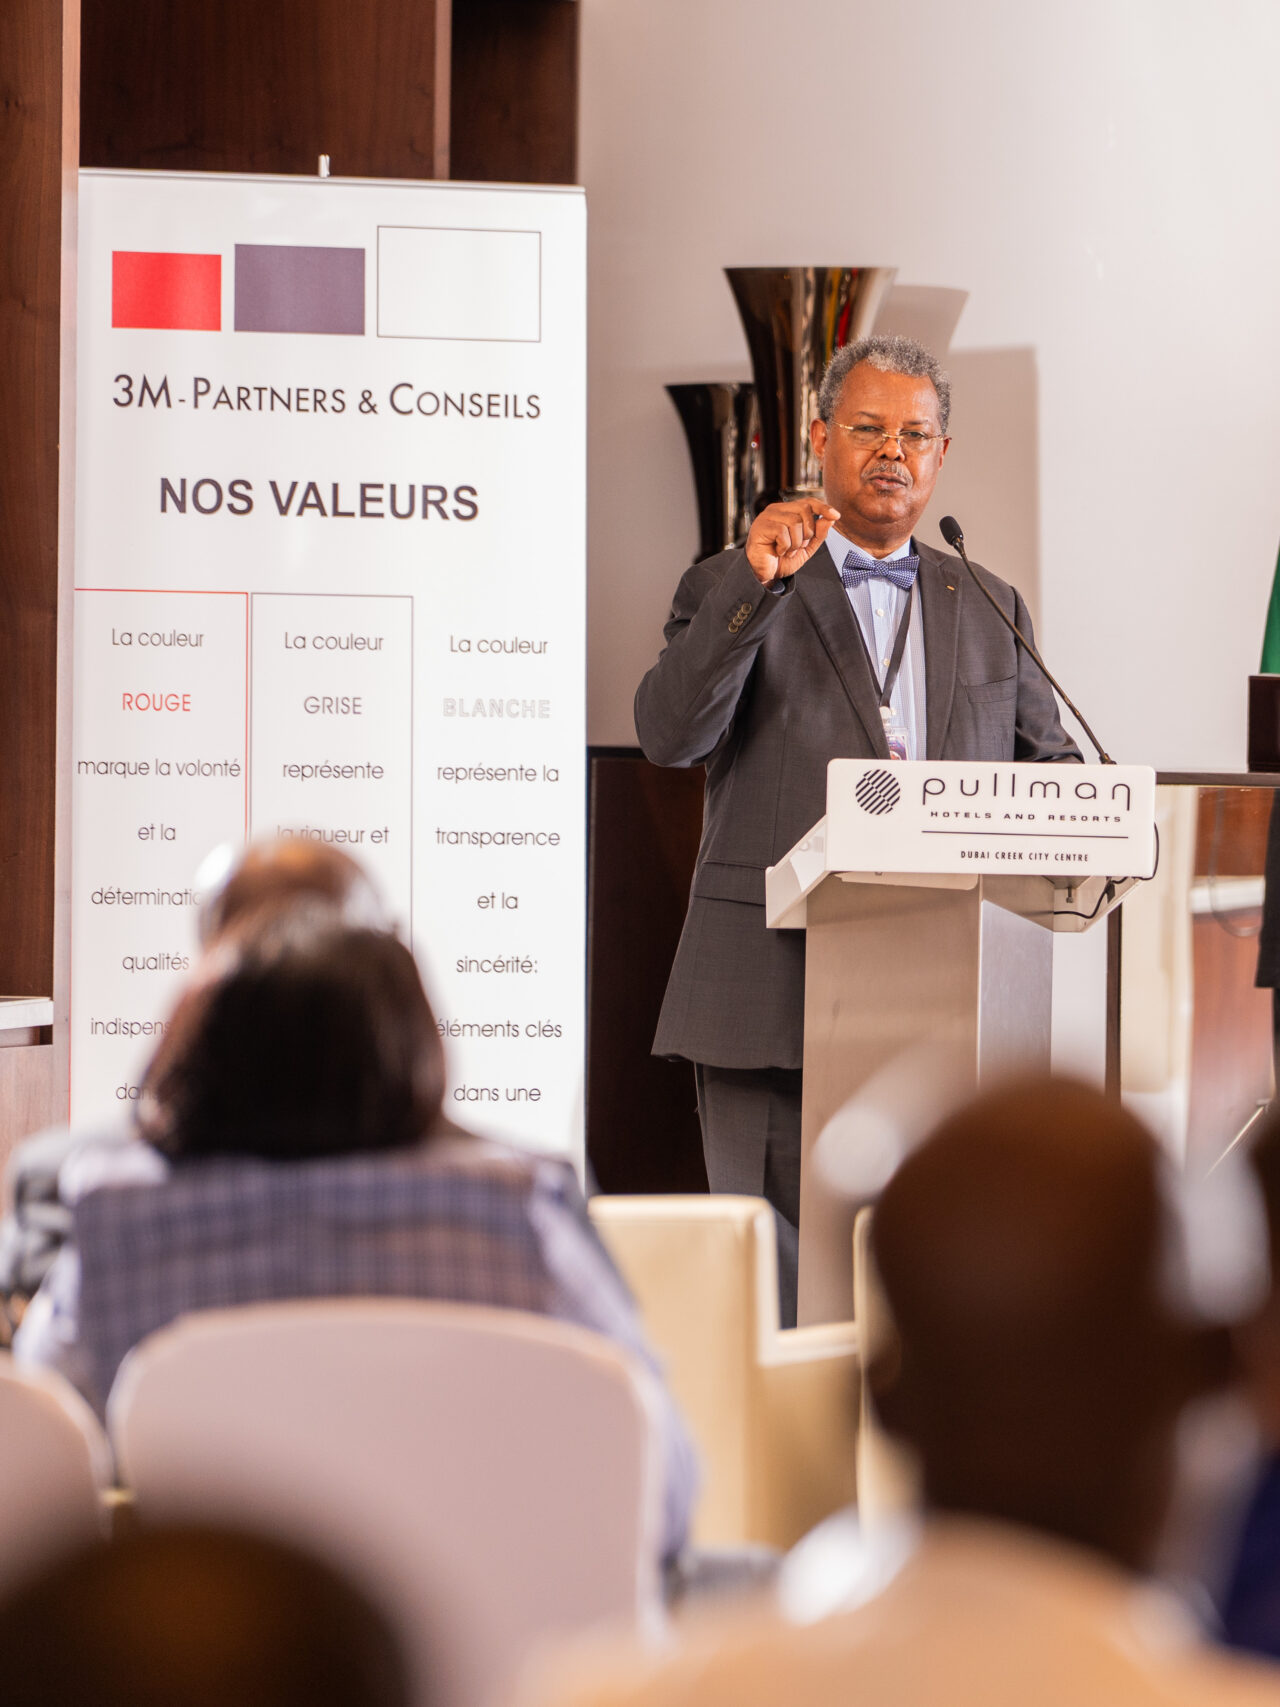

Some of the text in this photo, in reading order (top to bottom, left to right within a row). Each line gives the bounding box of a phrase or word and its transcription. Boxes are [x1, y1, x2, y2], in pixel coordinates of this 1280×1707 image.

[357, 389, 379, 415] &
[160, 477, 480, 523] NOS VALEURS
[111, 627, 205, 648] La couleur
[284, 631, 385, 652] La couleur
[449, 634, 549, 655] La couleur
[121, 692, 192, 713] ROUGE
[303, 695, 363, 716] GRISE
[442, 697, 551, 719] BLANCHE
[77, 758, 242, 779] marque la volonté
[282, 759, 385, 783] représente
[437, 762, 560, 785] représente la
[922, 773, 1131, 812] pullman
[930, 810, 1121, 823] HOTELS AND RESORTS
[136, 823, 177, 841] et la
[369, 826, 390, 844] et
[434, 826, 561, 849] transparence
[960, 850, 1089, 863] DUBAI CREEK CITY CENTRE
[91, 886, 202, 906] déterminatio
[476, 891, 519, 910] et la
[122, 952, 190, 973] qualités
[455, 954, 538, 974] sincérité:
[90, 1017, 170, 1038] indispens
[436, 1018, 563, 1038] éléments clés
[453, 1084, 542, 1102] dans une
